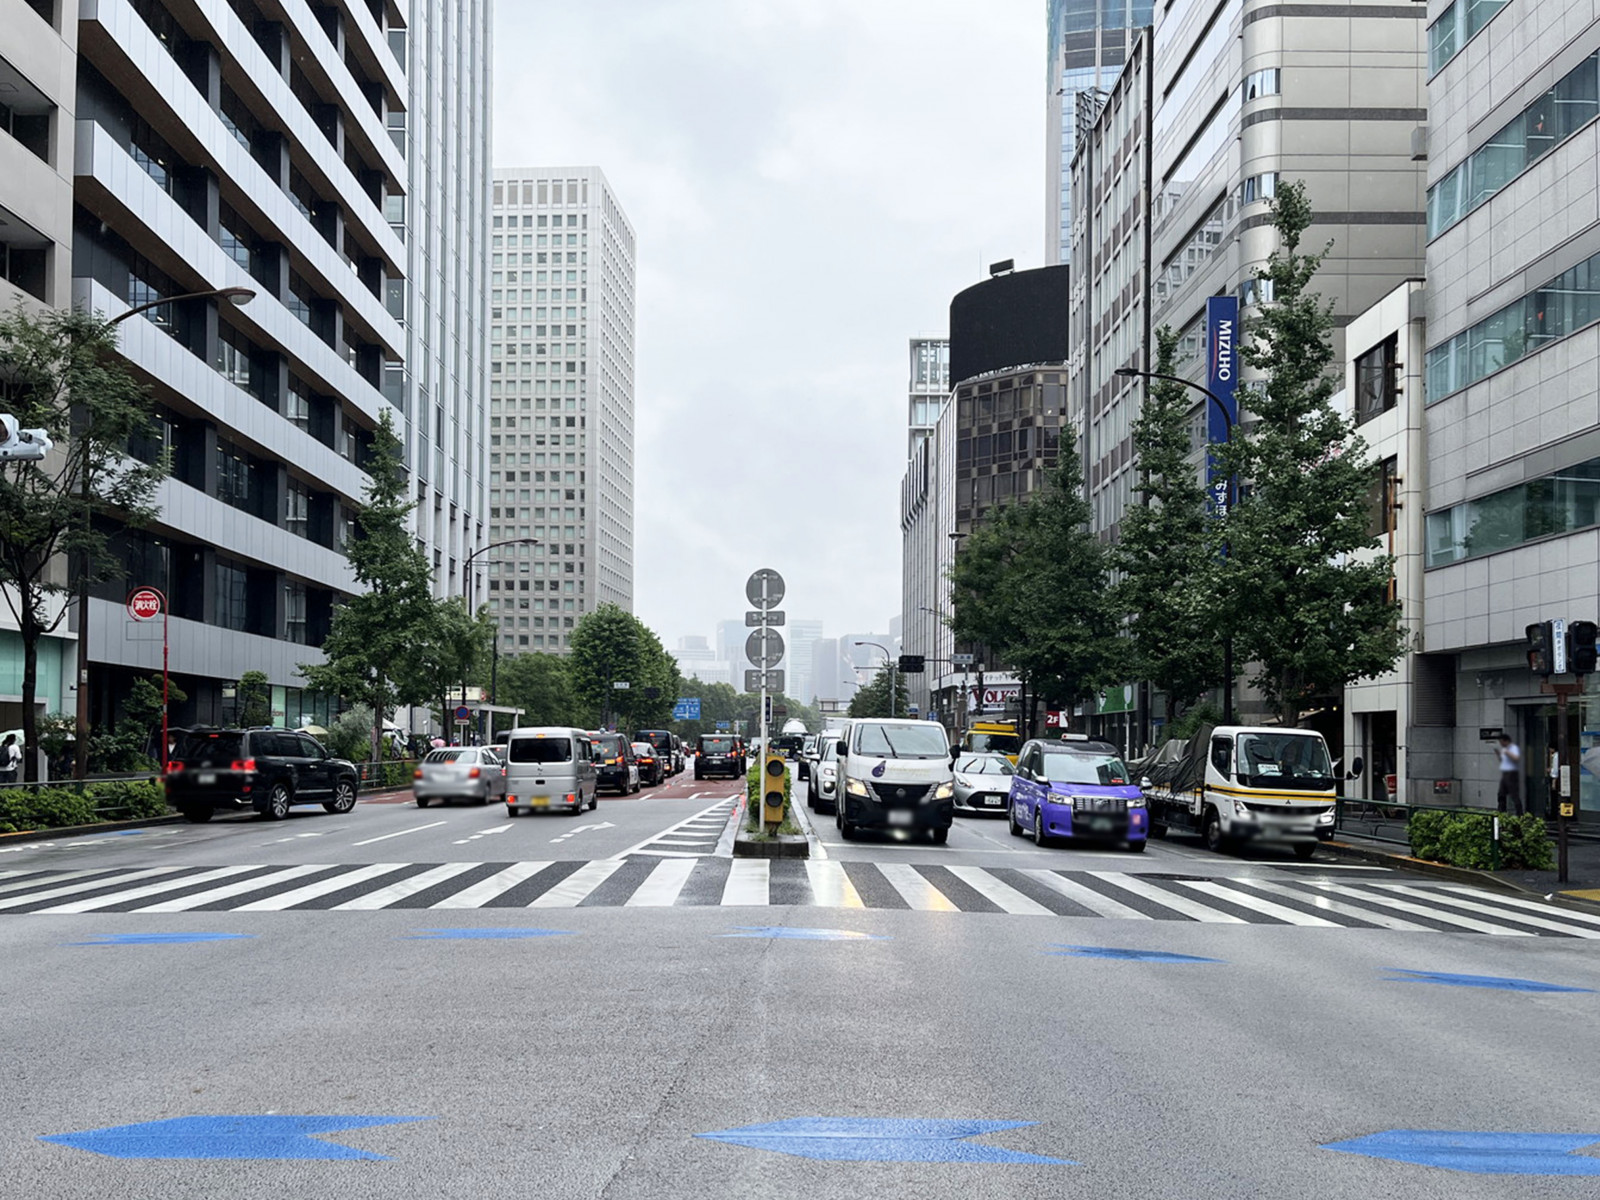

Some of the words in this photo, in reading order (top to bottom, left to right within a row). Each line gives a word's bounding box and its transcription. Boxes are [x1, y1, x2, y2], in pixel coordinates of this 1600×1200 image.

[1219, 320, 1232, 381] MIZUHO
[135, 600, 157, 610] 消火栓
[1047, 715, 1059, 724] 2F
